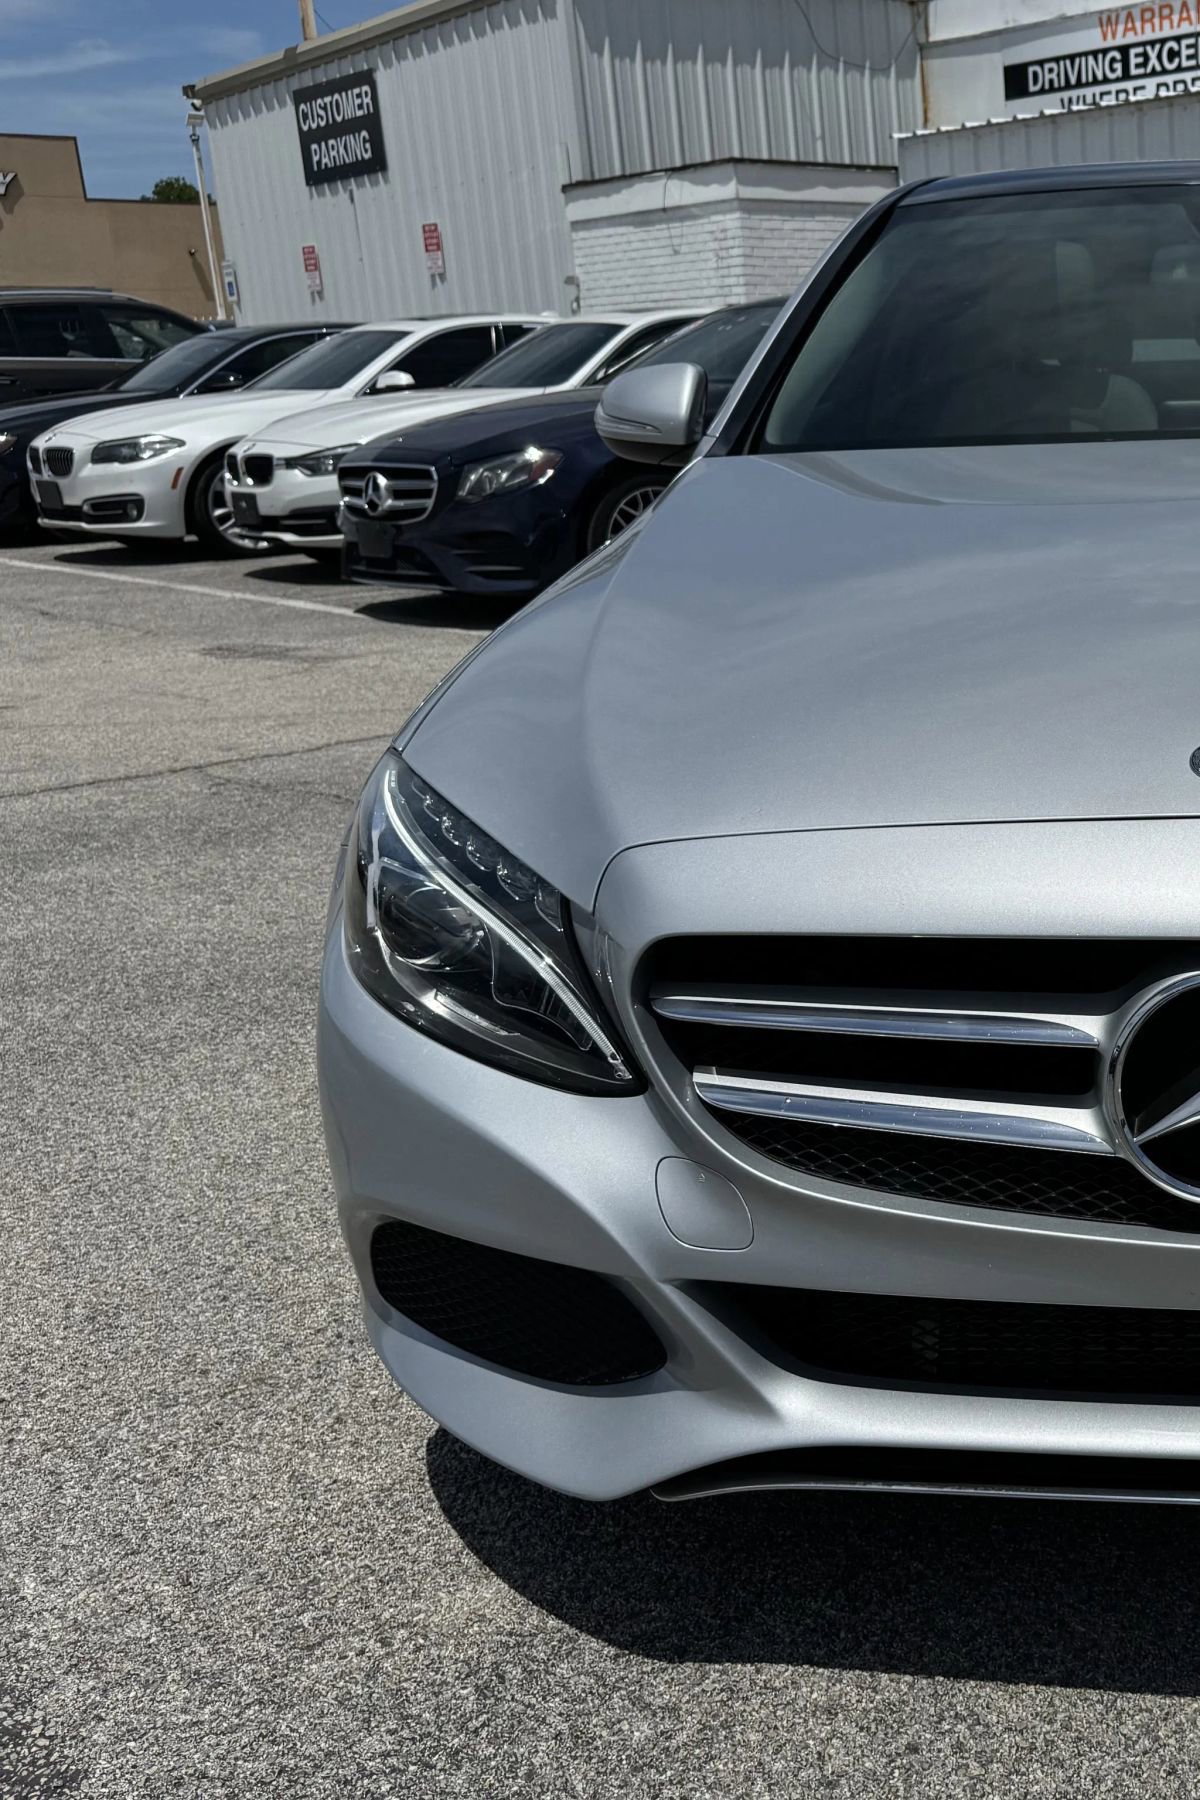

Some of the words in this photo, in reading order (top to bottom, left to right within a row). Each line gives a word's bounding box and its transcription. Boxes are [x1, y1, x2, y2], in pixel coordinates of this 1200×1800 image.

[1027, 53, 1123, 93] DRIVING
[299, 84, 374, 132] CUSTOMER
[310, 130, 373, 172] PARKING
